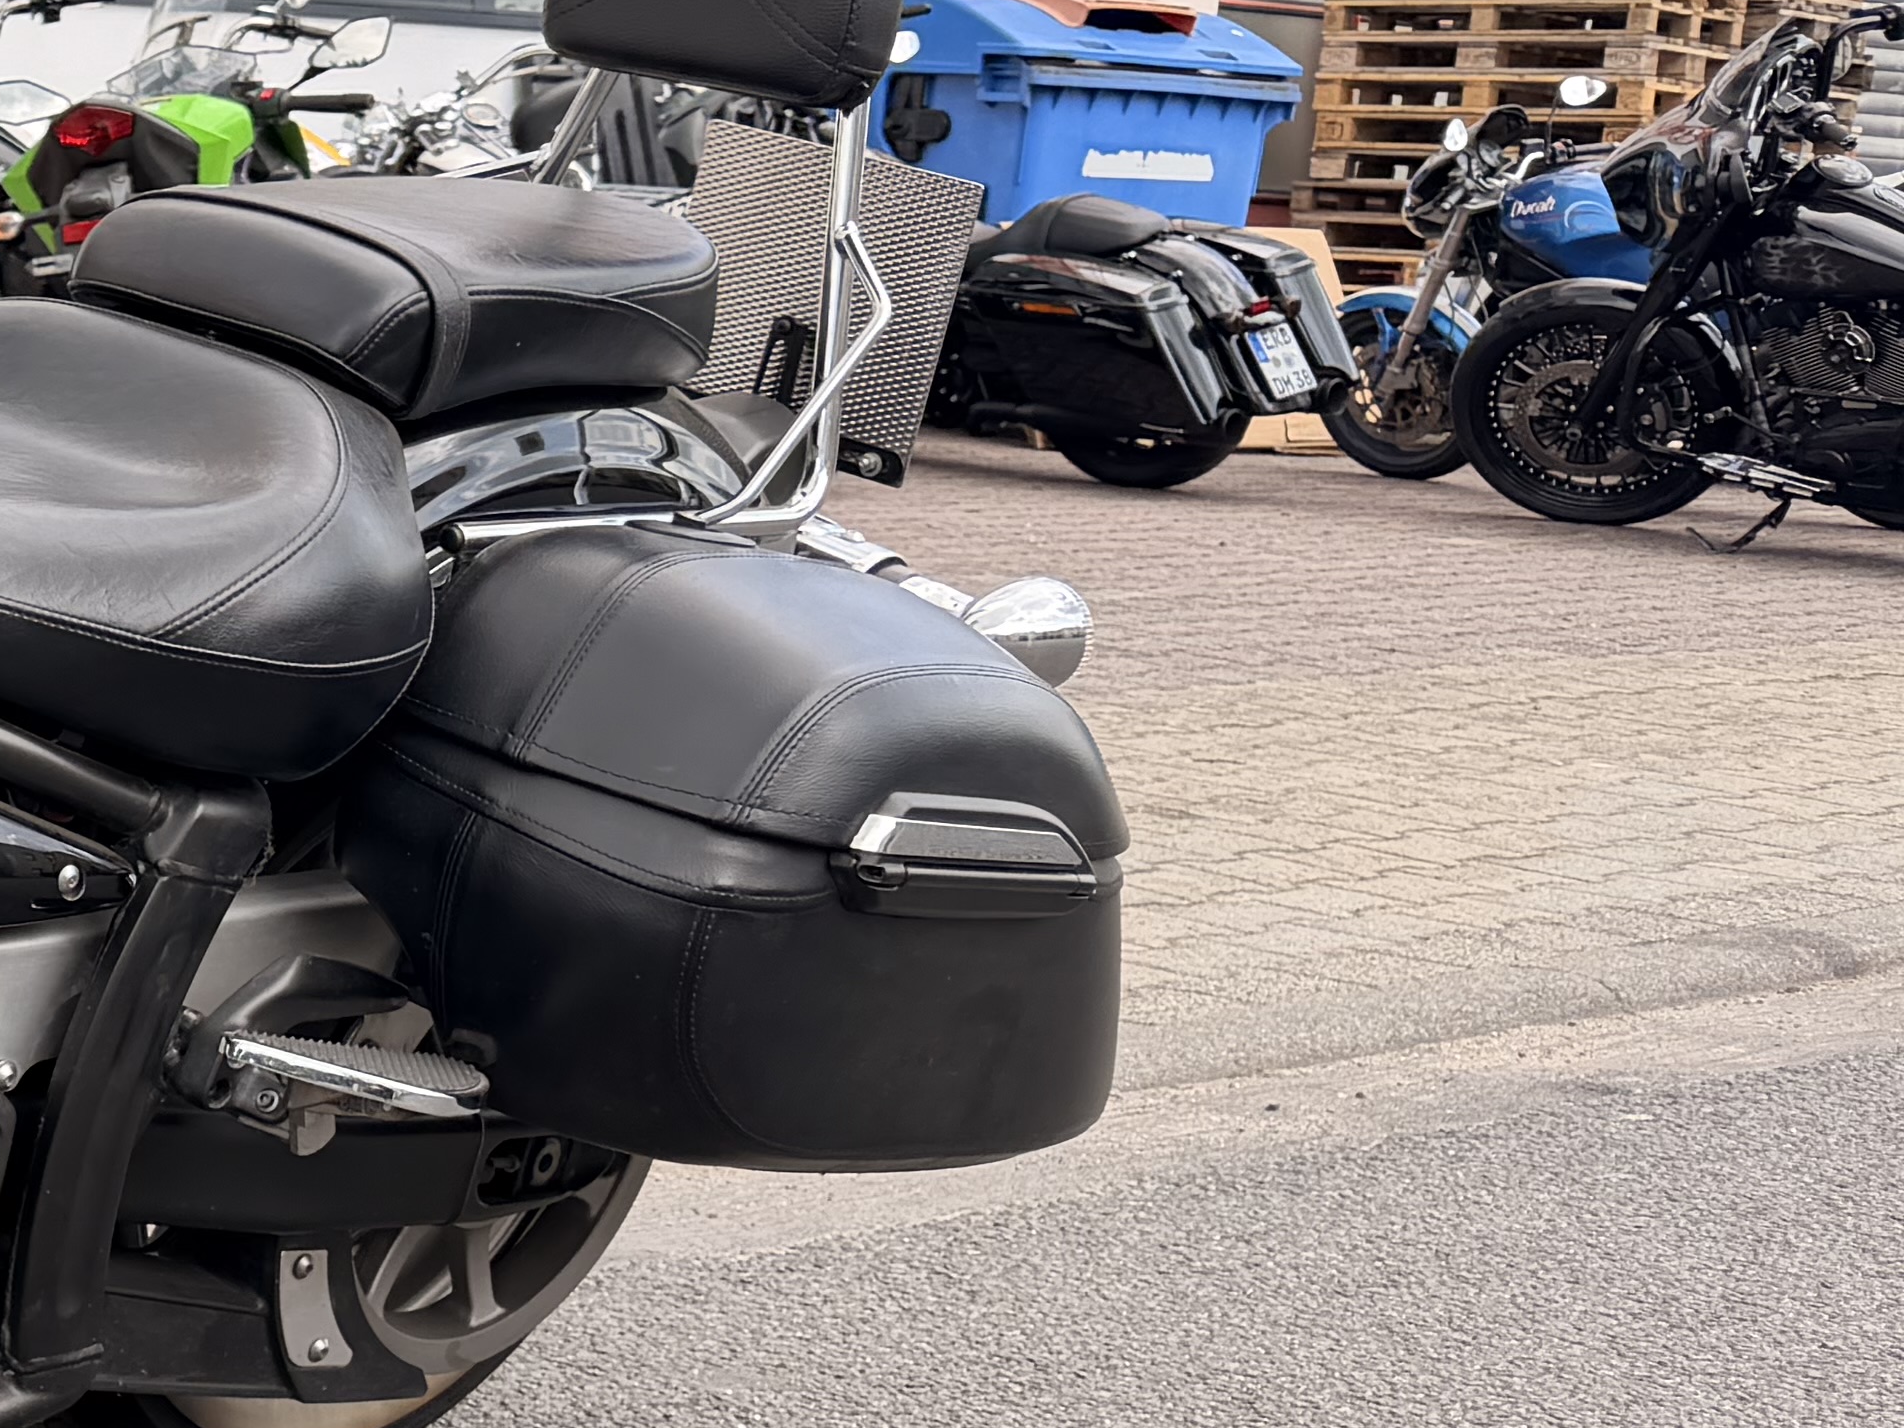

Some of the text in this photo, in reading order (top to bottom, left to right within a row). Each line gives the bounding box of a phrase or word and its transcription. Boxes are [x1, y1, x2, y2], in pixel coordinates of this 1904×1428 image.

[1510, 194, 1556, 219] Ducati
[1260, 327, 1292, 350] ERB
[1272, 374, 1295, 395] DM
